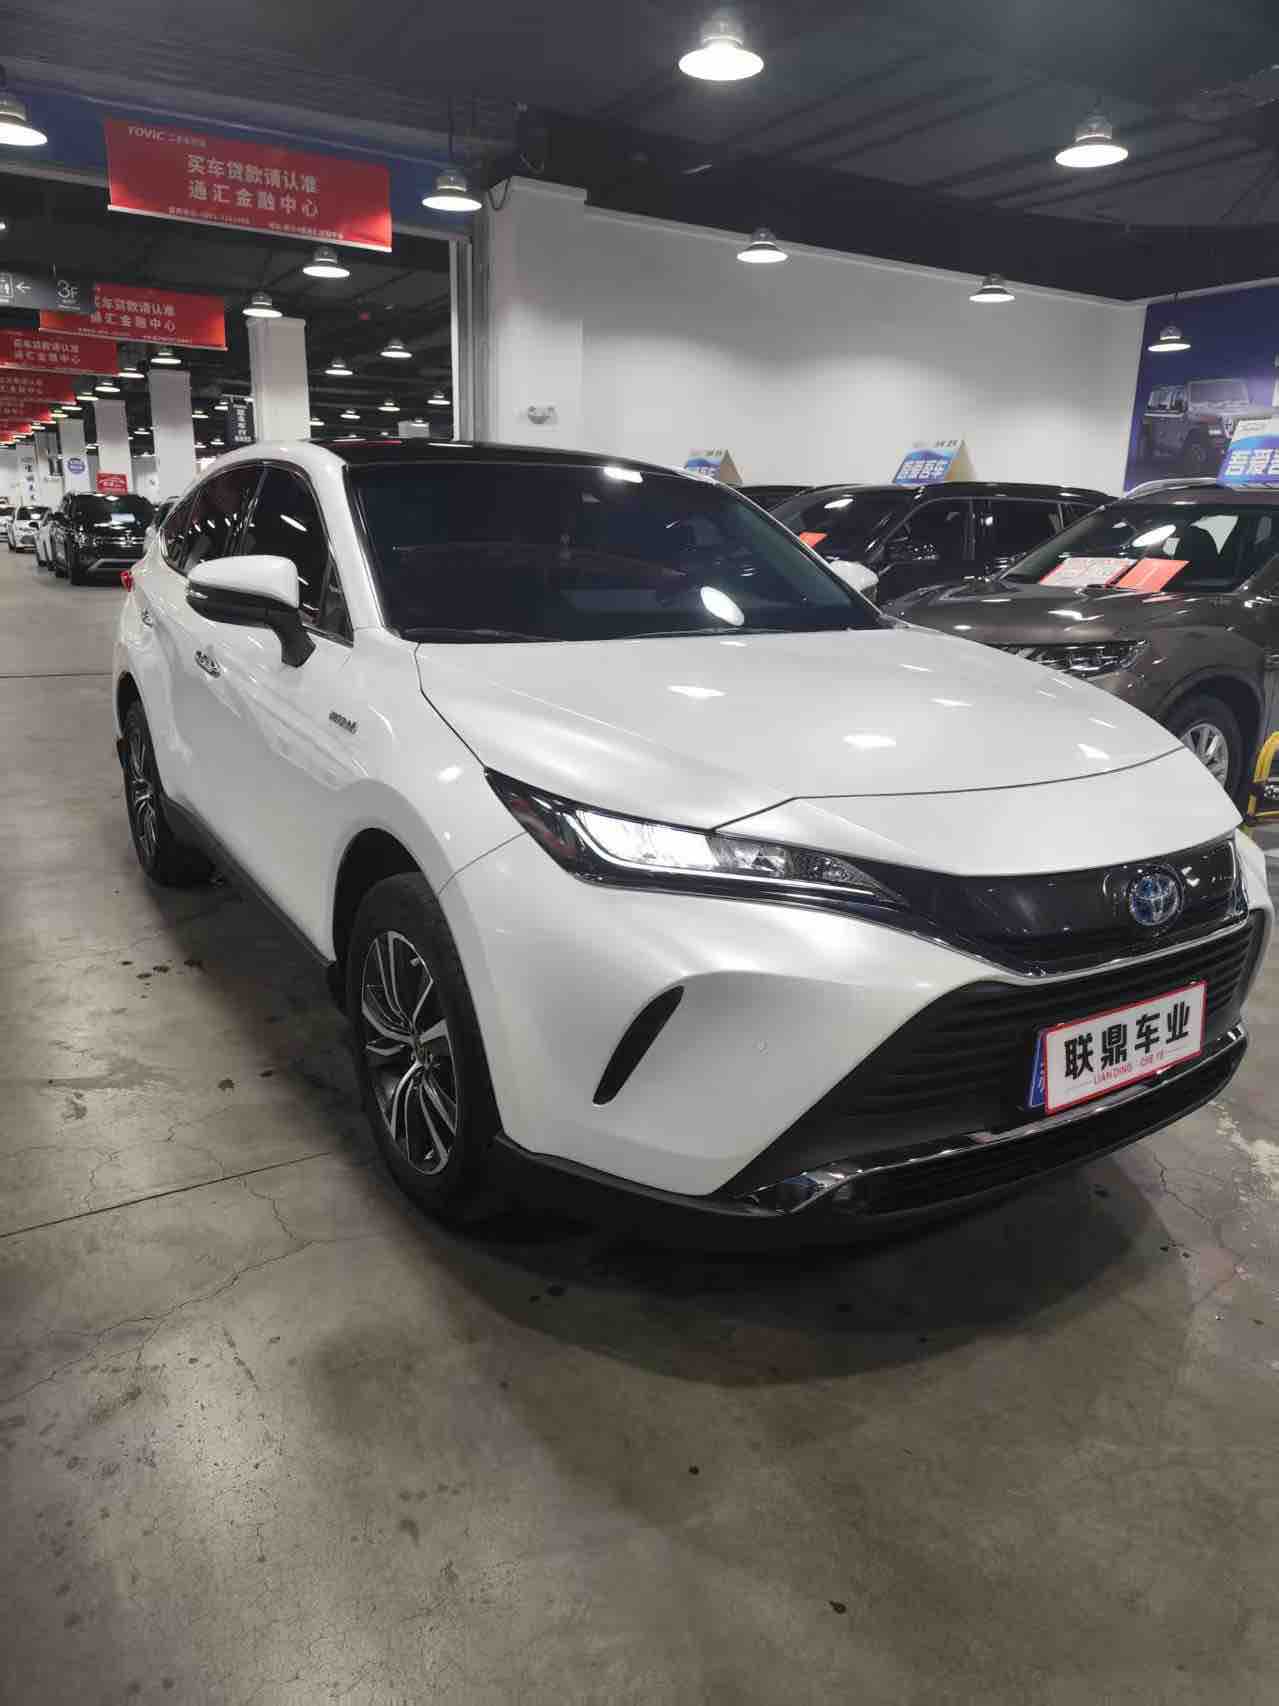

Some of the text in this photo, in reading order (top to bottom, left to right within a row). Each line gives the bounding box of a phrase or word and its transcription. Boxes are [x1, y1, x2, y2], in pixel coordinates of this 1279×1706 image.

[188, 154, 319, 193] 买车贷款请认准
[188, 180, 319, 217] 通汇金融中心
[57, 280, 78, 298] 3F
[1064, 1001, 1190, 1080] 联鼎车业
